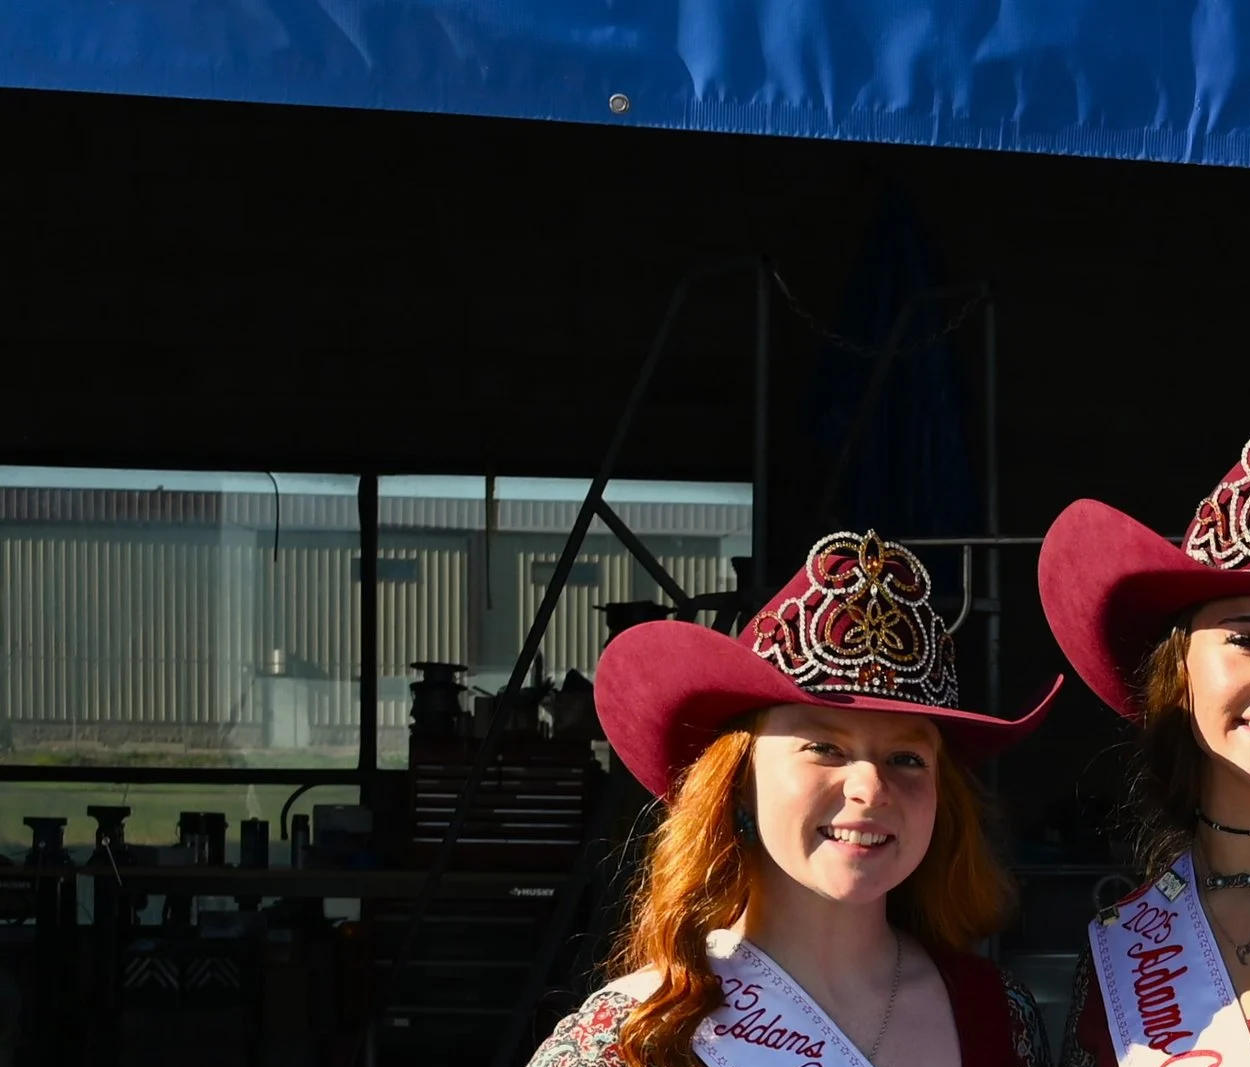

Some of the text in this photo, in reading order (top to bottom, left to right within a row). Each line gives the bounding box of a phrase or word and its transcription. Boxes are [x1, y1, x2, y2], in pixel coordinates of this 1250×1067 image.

[522, 887, 556, 897] HUSKY
[1122, 901, 1178, 944] 2025
[1127, 943, 1194, 1056] Adams
[714, 1008, 826, 1059] Adams
